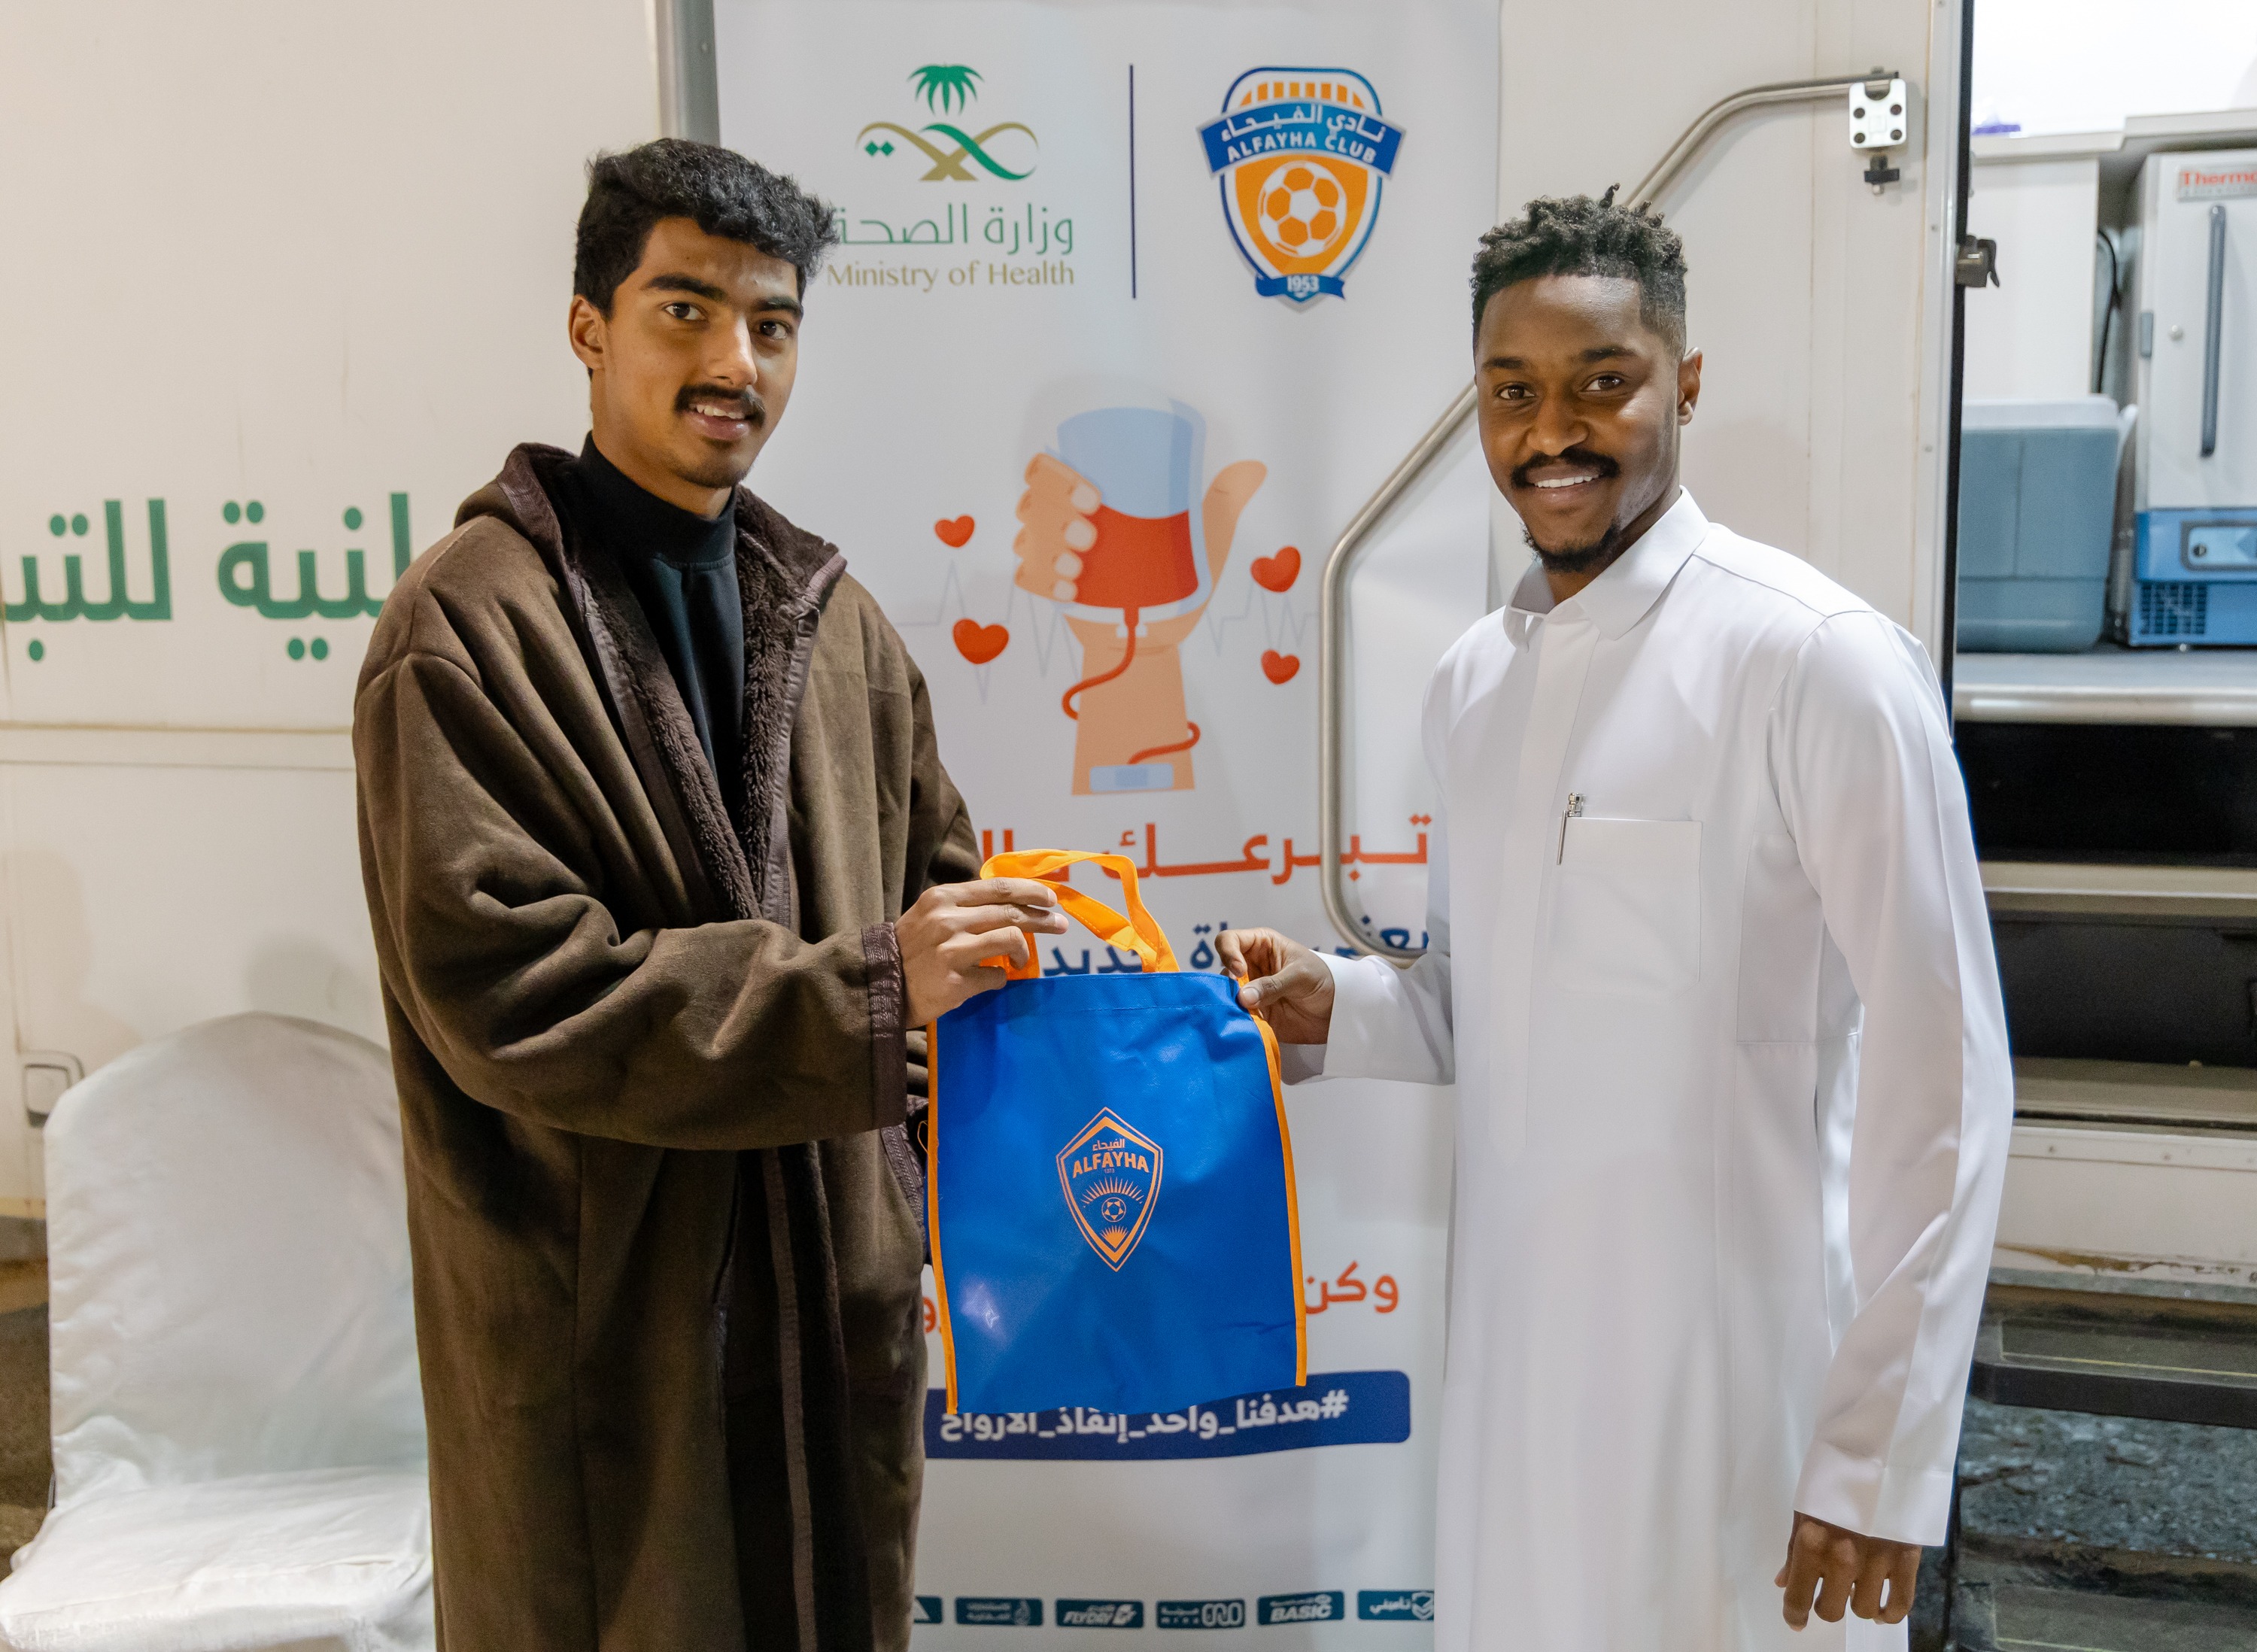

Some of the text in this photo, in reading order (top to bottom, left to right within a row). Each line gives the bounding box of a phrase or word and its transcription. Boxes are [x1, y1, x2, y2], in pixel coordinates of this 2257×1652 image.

[1221, 103, 1387, 143] نادي الفيحاء
[1227, 132, 1378, 164] ALFAYHA CLUB
[984, 202, 1073, 255] وزارة
[828, 260, 1074, 293] Ministry of Health
[1287, 275, 1320, 293] 1953
[1092, 1138, 1125, 1151] الفيحاء
[1073, 1152, 1150, 1178] ALFAYHA
[1305, 1261, 1399, 1314] وكن
[1270, 1603, 1332, 1623] BASIC
